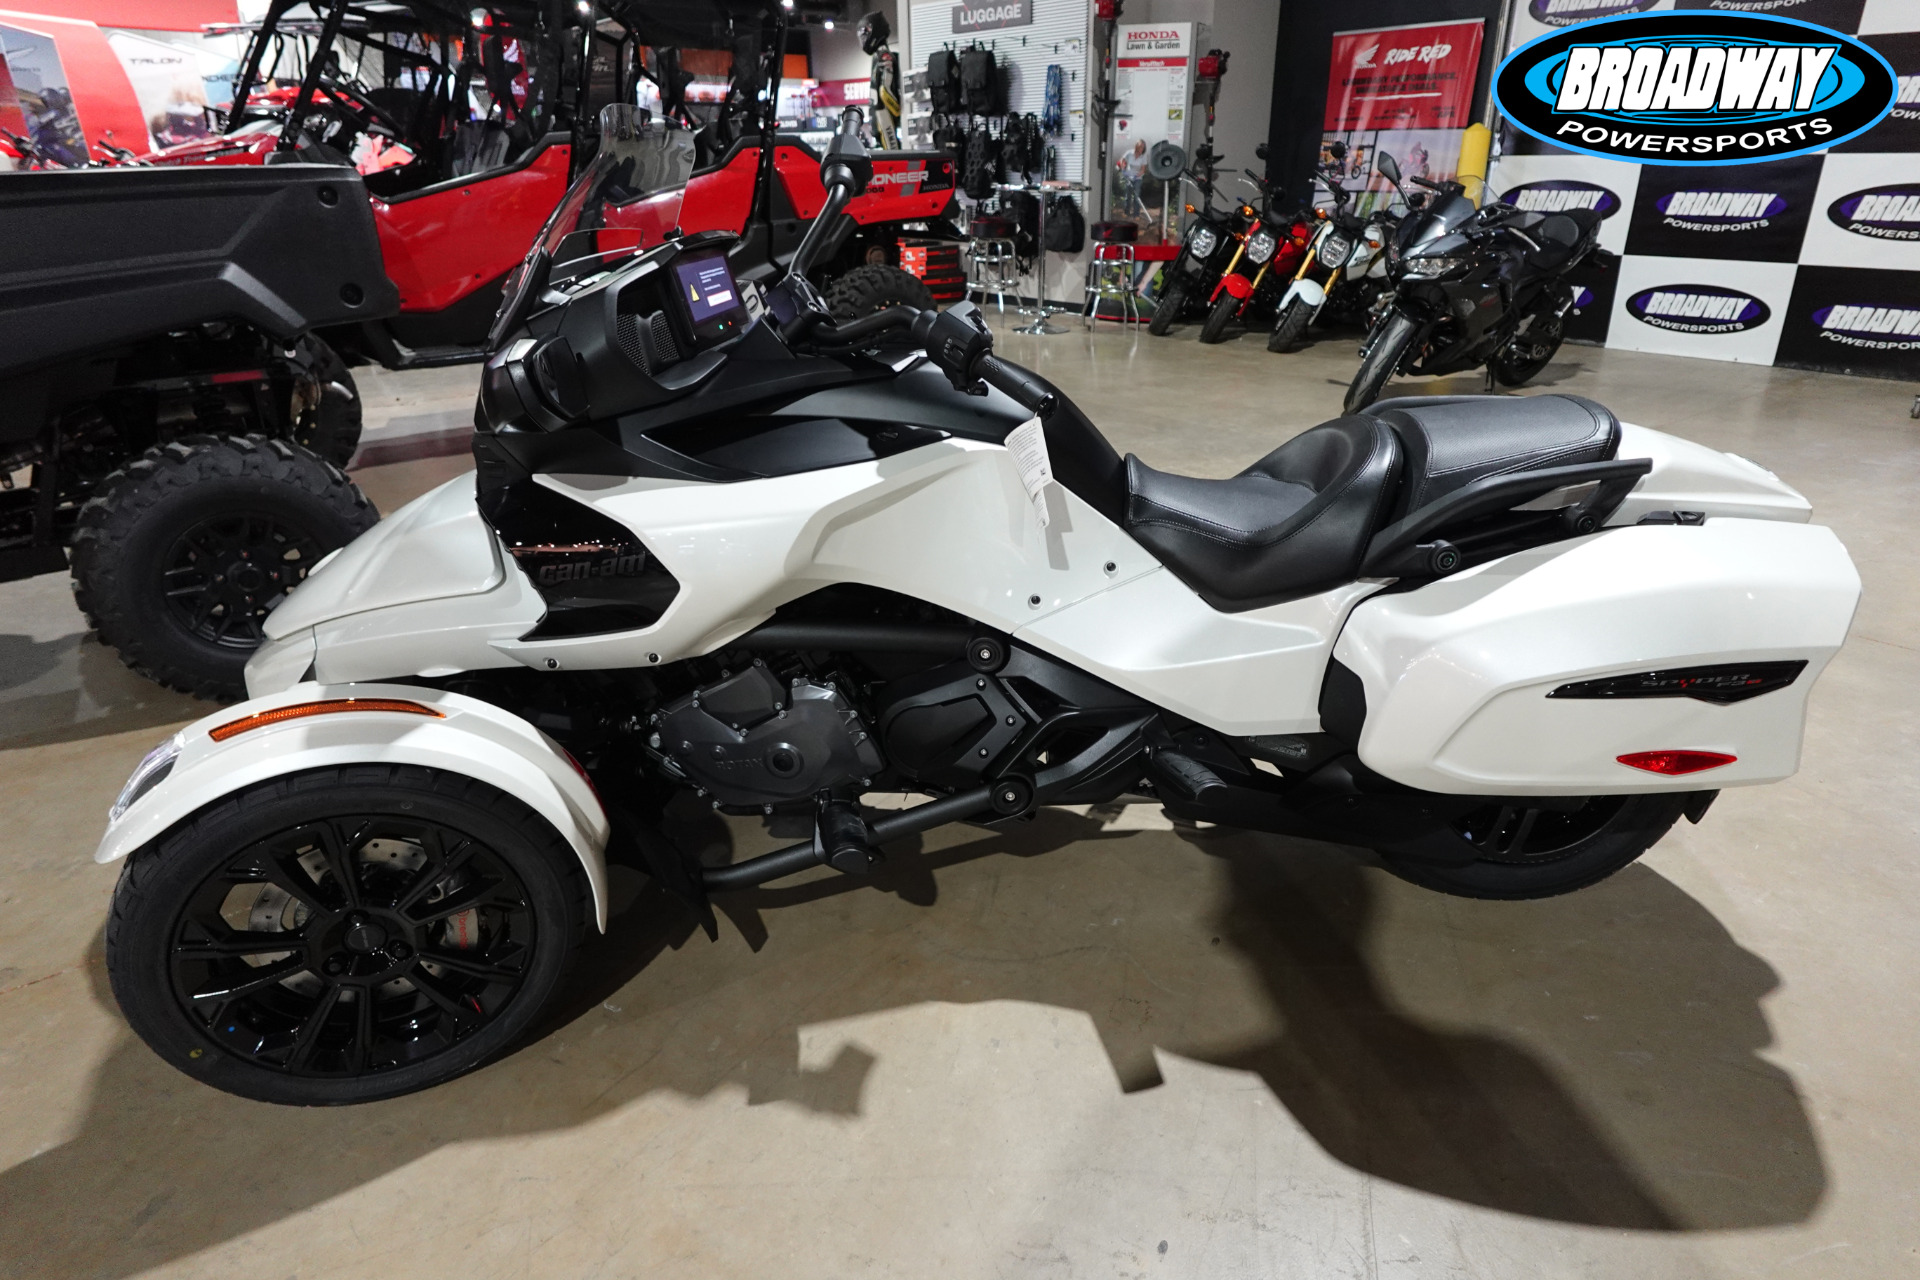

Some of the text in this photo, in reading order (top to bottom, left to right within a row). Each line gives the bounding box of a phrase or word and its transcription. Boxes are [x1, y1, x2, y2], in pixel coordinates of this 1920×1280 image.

[960, 4, 1022, 25] LUGGAGE
[1127, 31, 1180, 40] HONDA
[1126, 41, 1181, 51] Lawn & Garden
[1383, 44, 1453, 66] RIDE RED
[128, 57, 183, 65] TALON
[1515, 190, 1605, 212] BROADWAY
[1665, 191, 1778, 218] BROADWAY
[1663, 217, 1770, 232] POWERSPORTS
[1644, 292, 1752, 321] BROADWAY
[1643, 315, 1745, 332] POWERSPORTS
[538, 553, 647, 584] can-am
[1641, 674, 1750, 687] SPYDER
